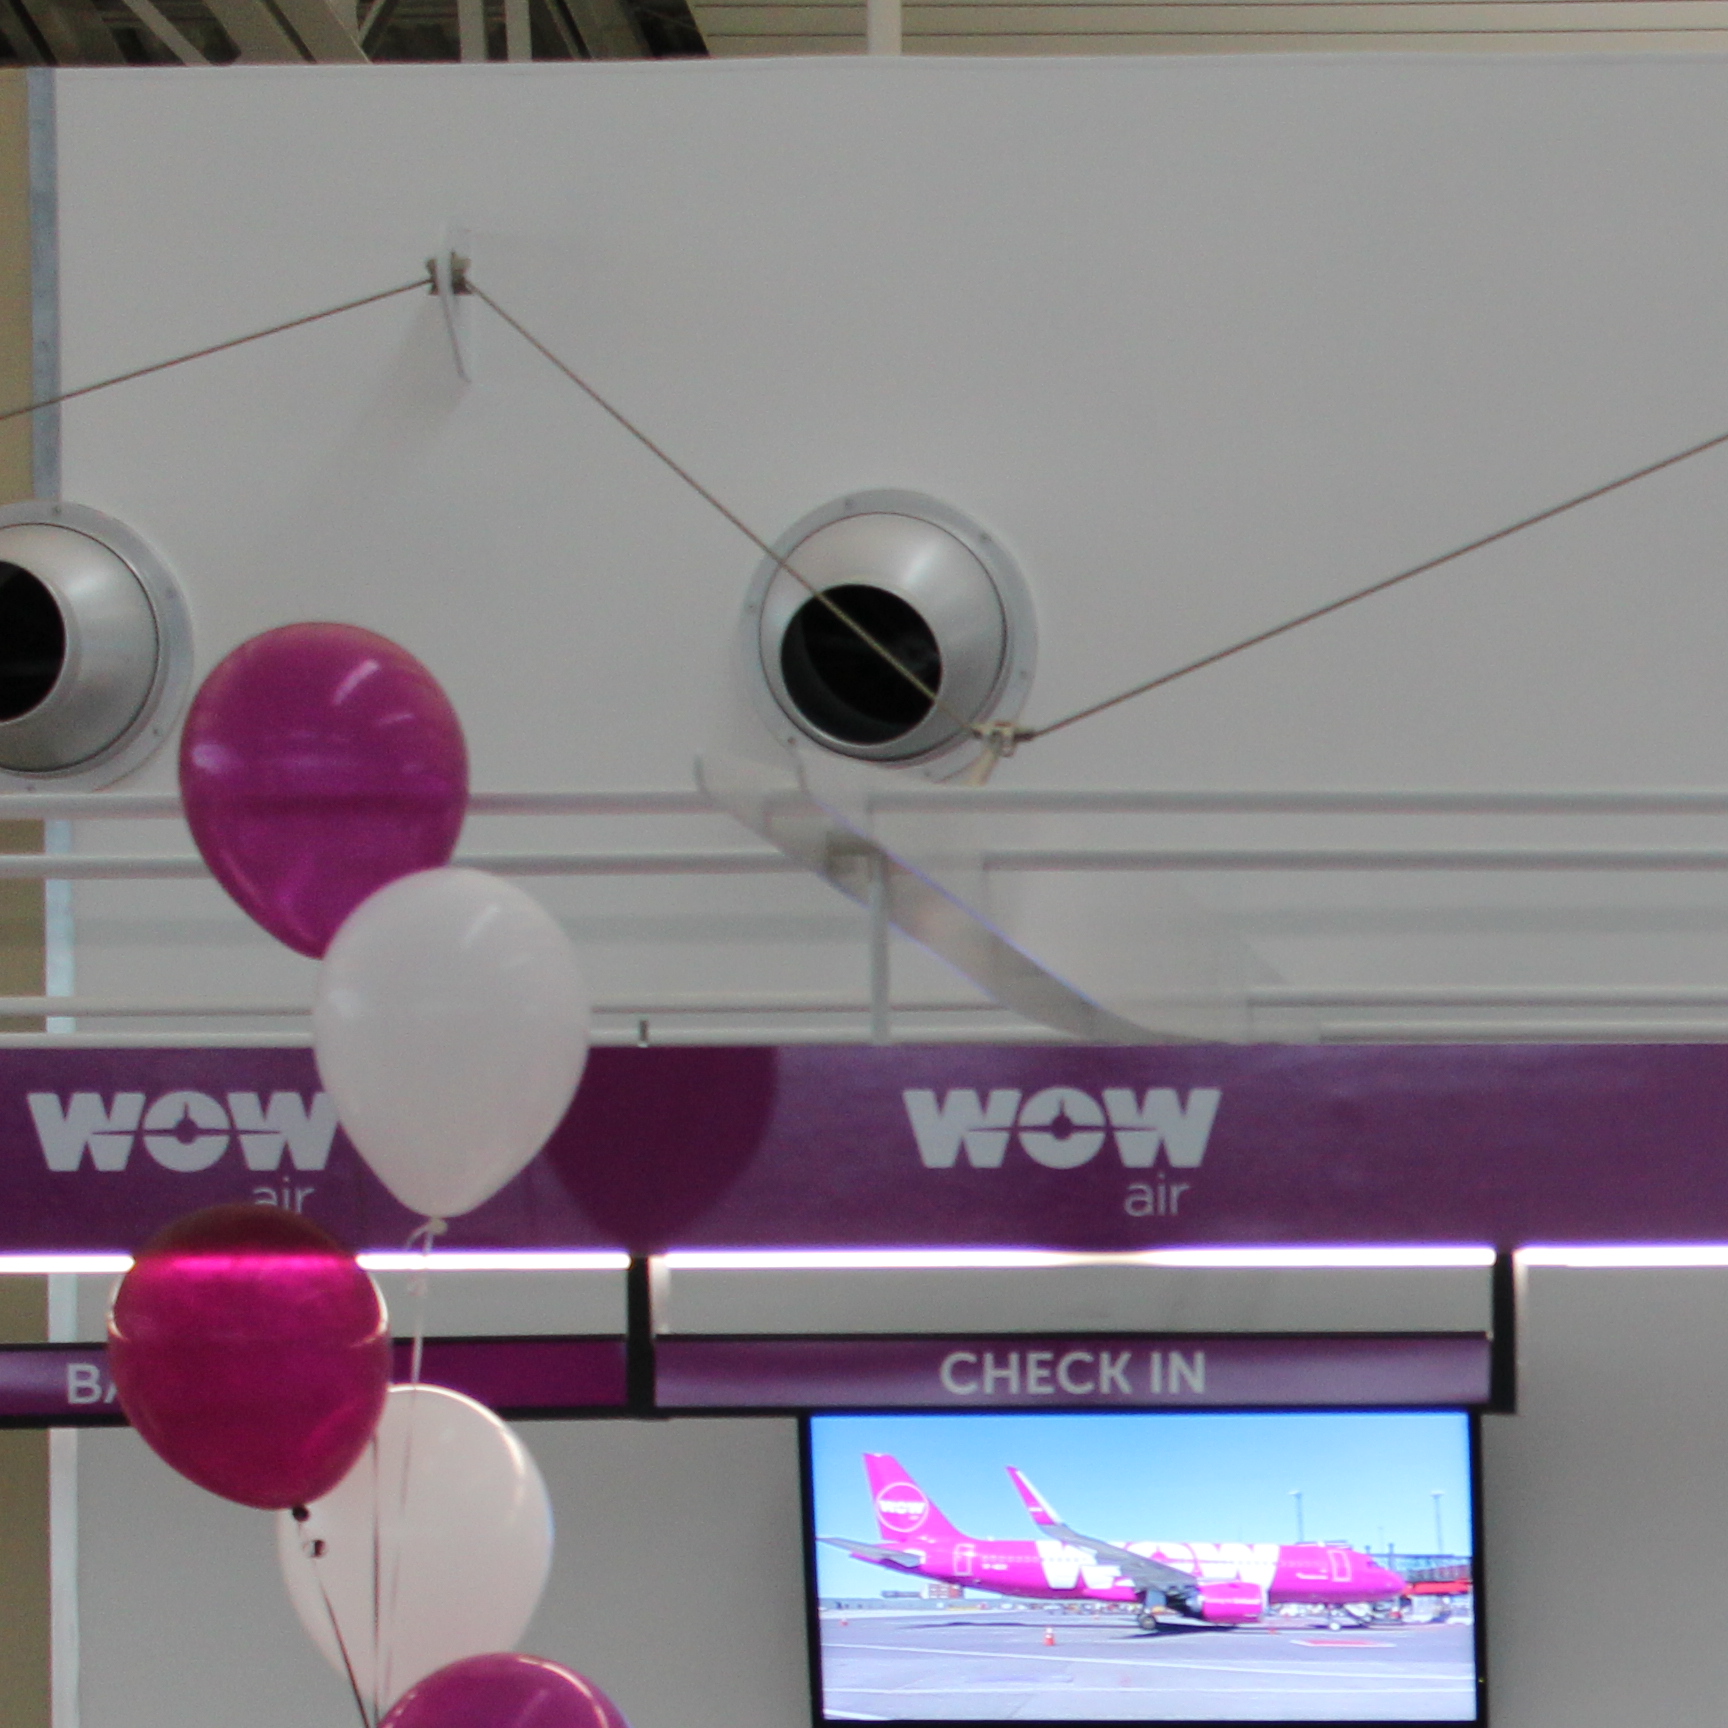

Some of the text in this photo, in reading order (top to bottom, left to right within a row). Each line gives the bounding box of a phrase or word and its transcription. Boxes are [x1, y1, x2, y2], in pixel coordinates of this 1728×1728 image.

[26, 1091, 340, 1172] WOW
[902, 1087, 1222, 1169] WOW
[1123, 1172, 1191, 1217] air
[939, 1351, 1205, 1395] CHECK IN
